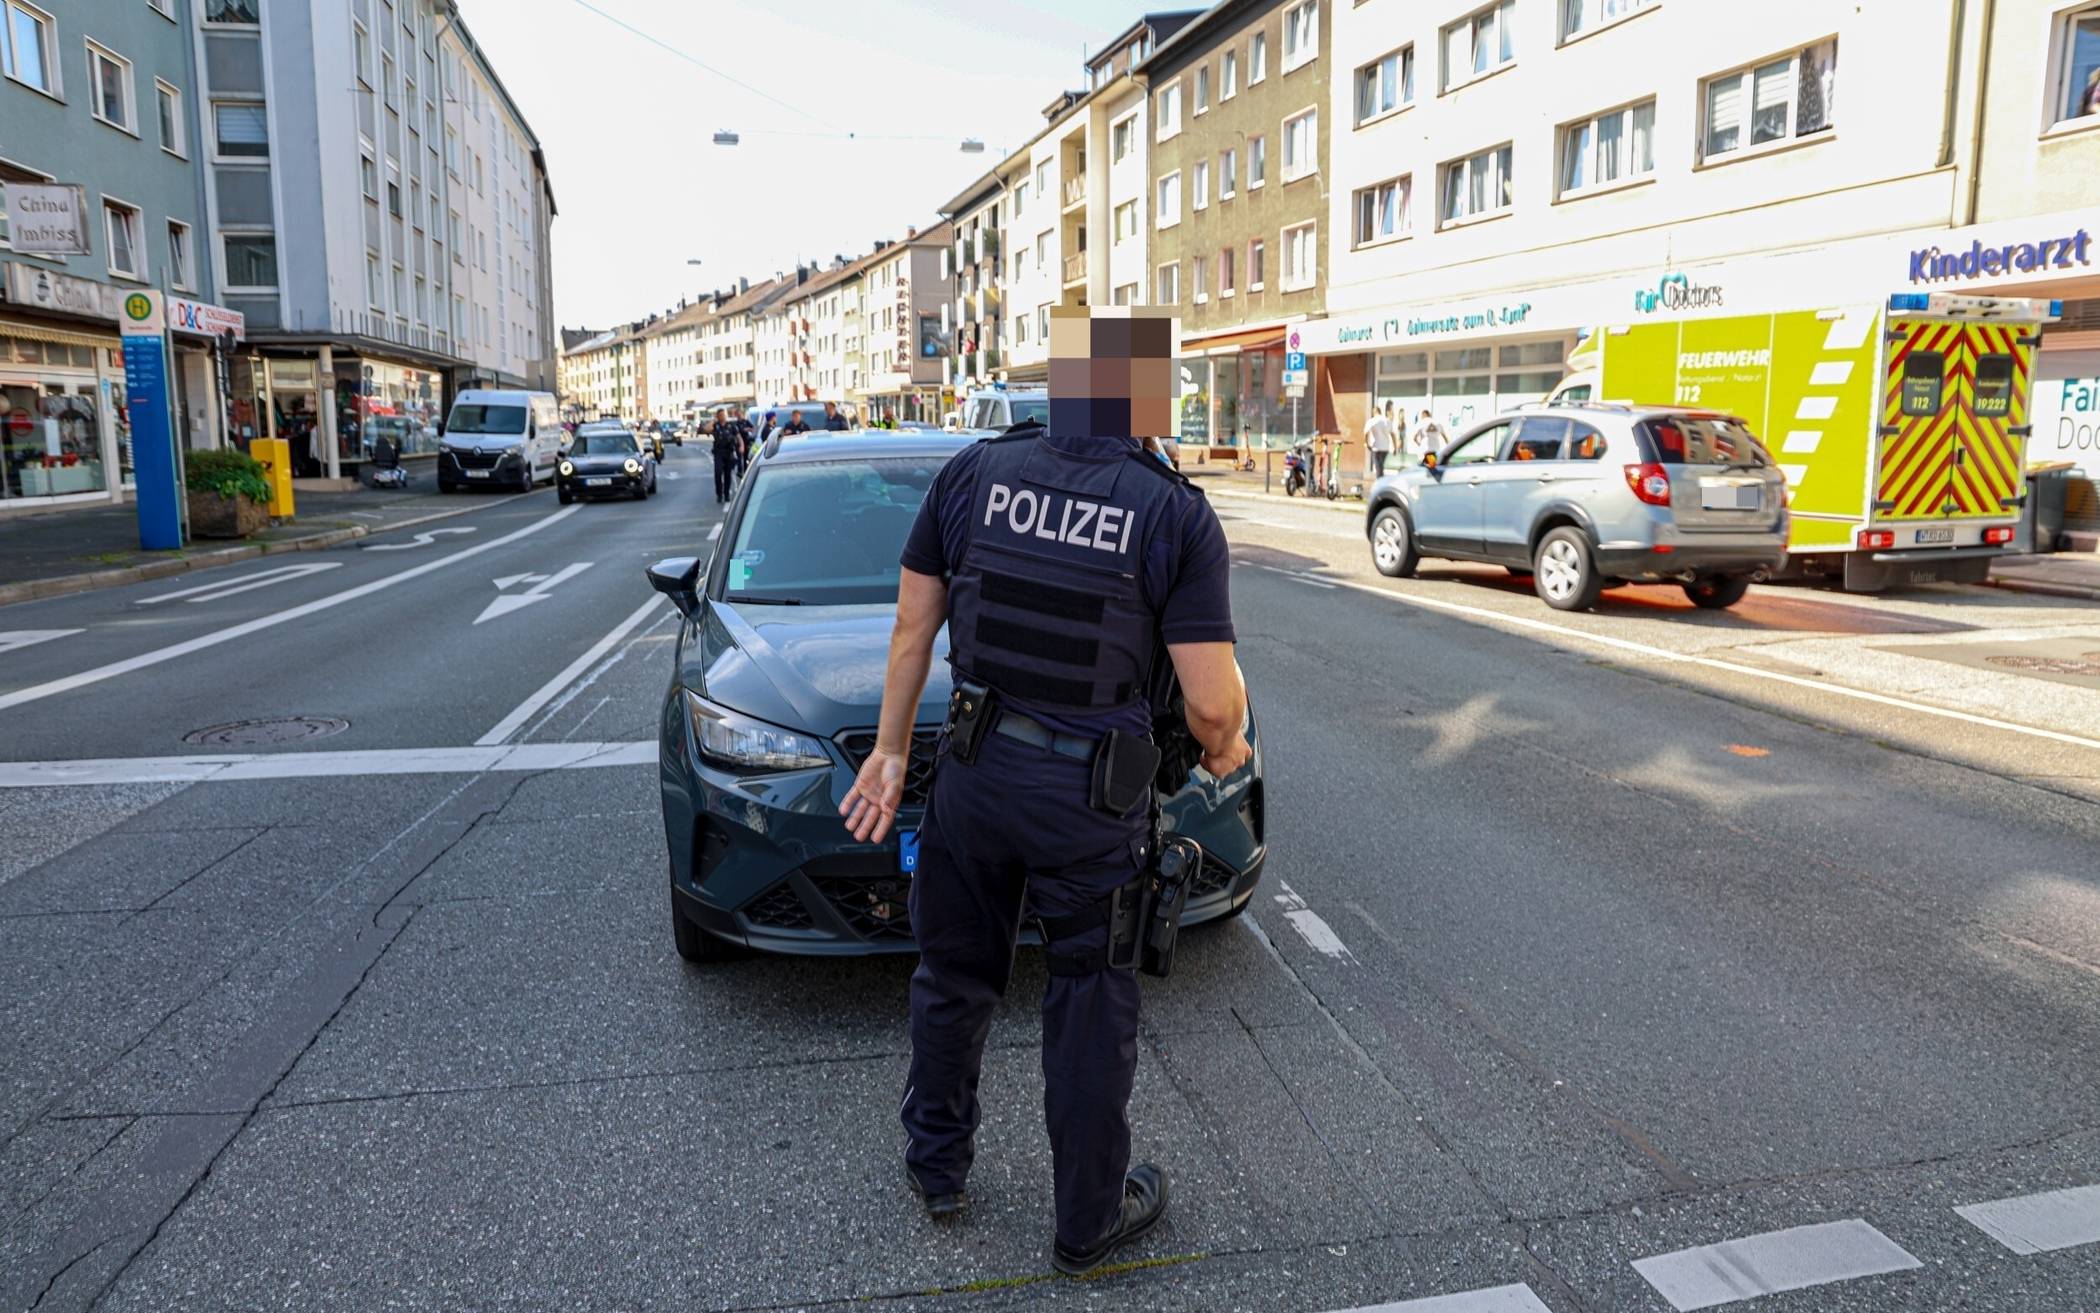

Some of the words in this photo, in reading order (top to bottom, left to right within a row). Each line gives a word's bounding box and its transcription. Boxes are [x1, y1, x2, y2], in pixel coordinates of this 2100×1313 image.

[18, 195, 69, 213] China
[17, 224, 77, 241] Imbiss
[1909, 229, 2092, 285] Kinderarzt
[177, 302, 203, 330] D&C
[1290, 354, 1301, 369] P
[1679, 349, 1770, 369] FEUERWEHR
[1677, 385, 1702, 403] 112
[1912, 397, 1929, 409] 112
[2061, 377, 2100, 412] Fai
[1977, 398, 2007, 410] 19222
[984, 483, 1135, 554] POLIZEI
[907, 856, 914, 865] D
